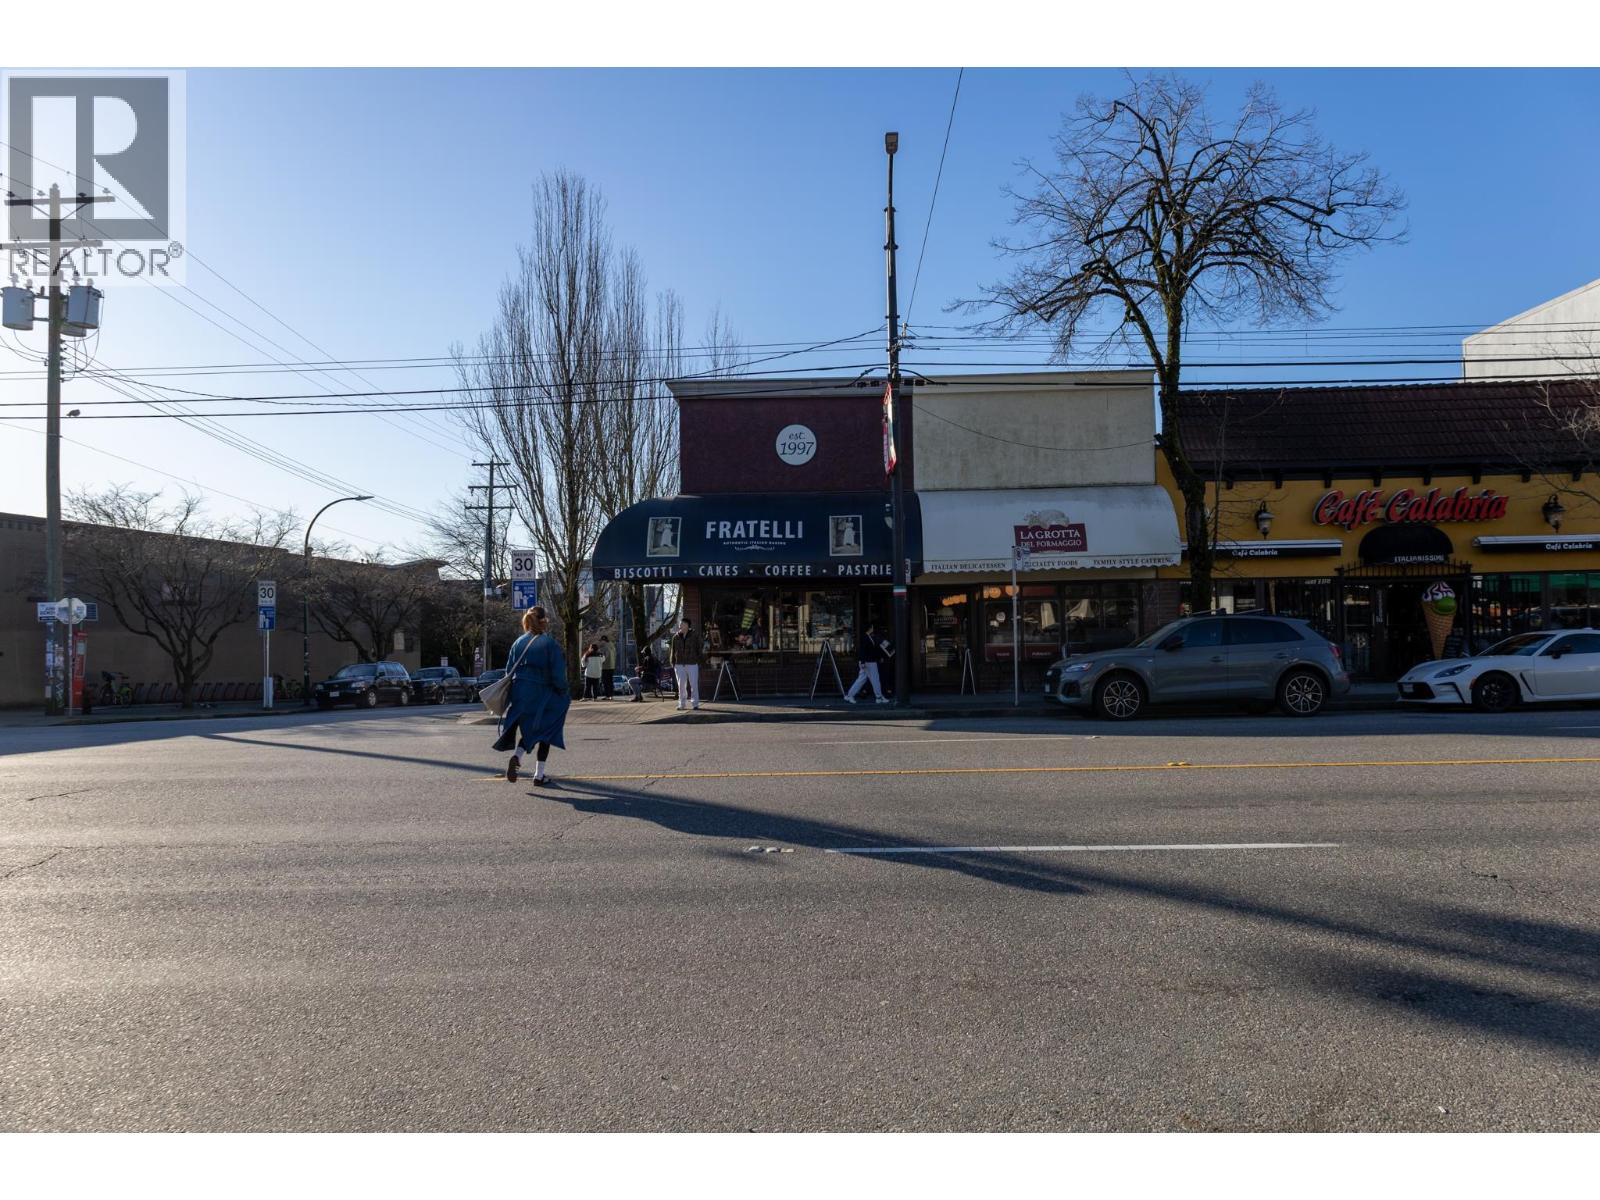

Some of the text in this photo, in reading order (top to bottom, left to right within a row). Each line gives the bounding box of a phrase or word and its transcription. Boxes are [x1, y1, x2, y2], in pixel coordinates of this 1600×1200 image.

[779, 441, 815, 456] 1997
[1312, 487, 1508, 533] Café Calabria
[705, 520, 803, 539] FRATELLI
[1020, 529, 1081, 540] LA GROTTA
[1036, 539, 1082, 548] FORMAGGIO
[1544, 543, 1561, 551] Café
[1231, 549, 1248, 557] Café
[514, 558, 533, 571] 30
[614, 564, 892, 579] BISCOTTI CAKES COFFEE PASTRIE
[260, 587, 273, 599] 30
